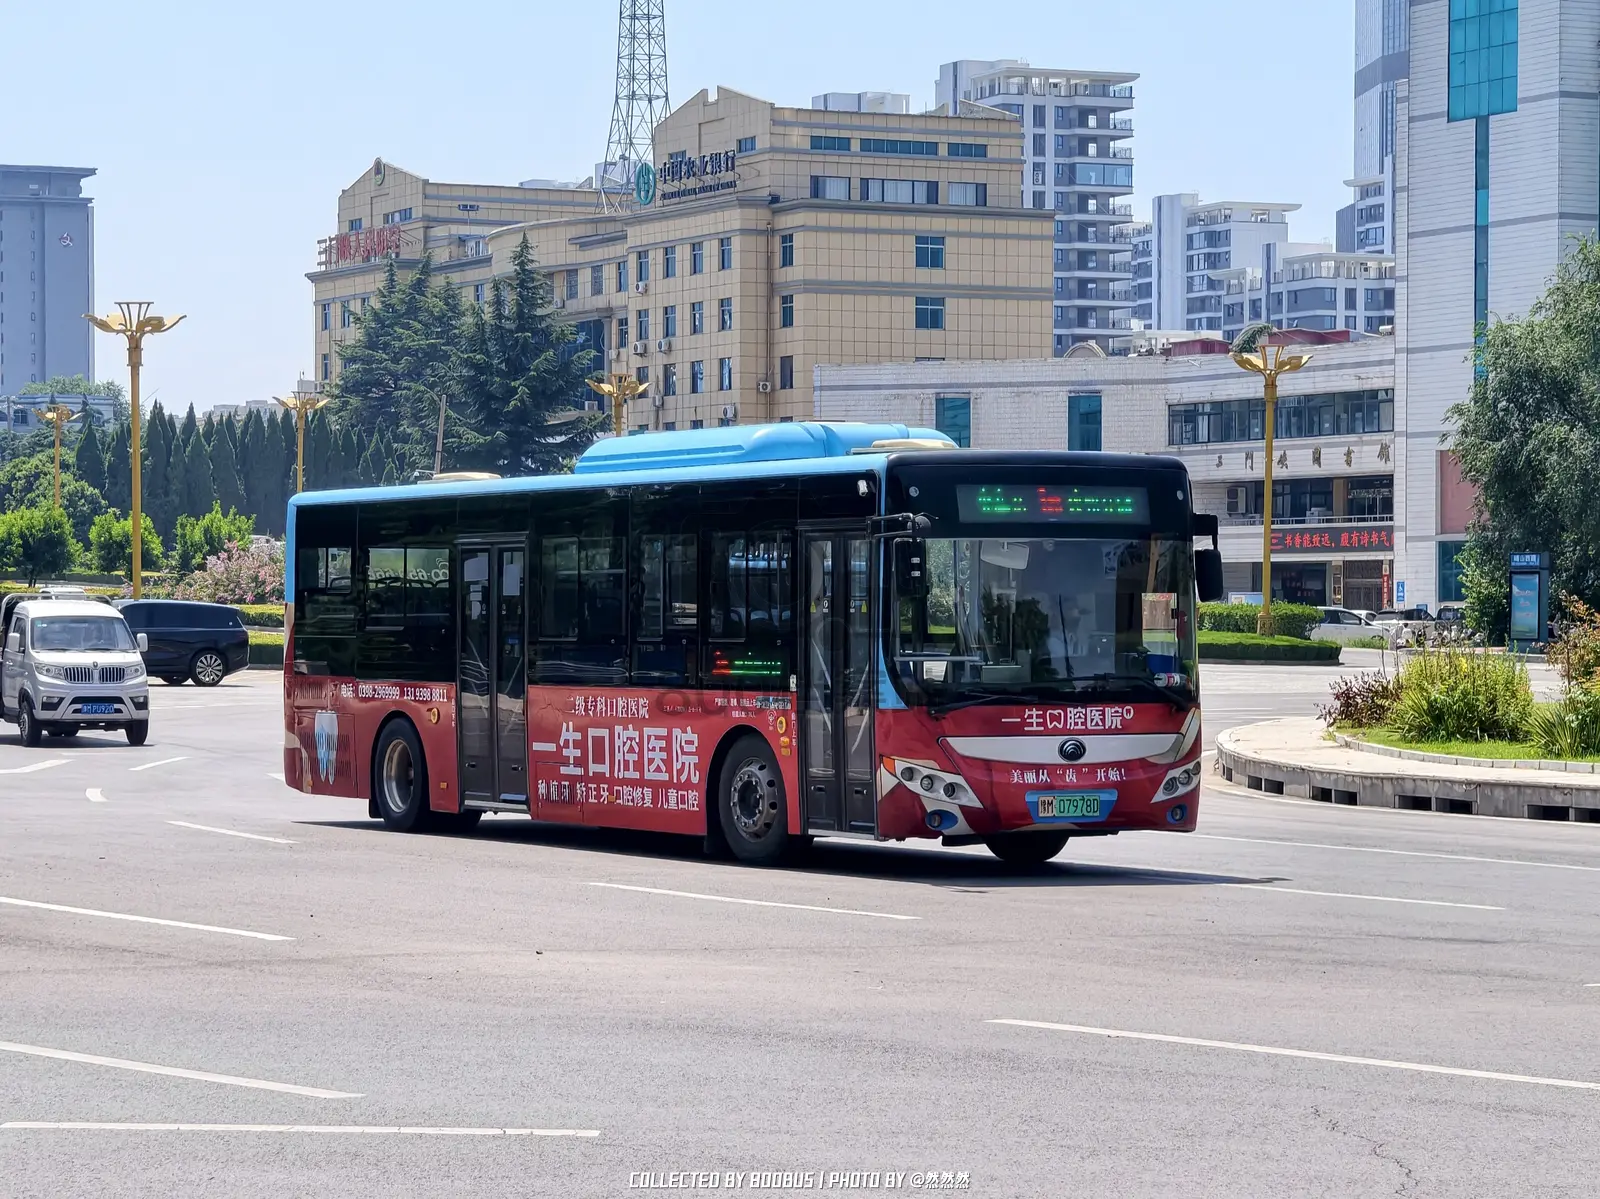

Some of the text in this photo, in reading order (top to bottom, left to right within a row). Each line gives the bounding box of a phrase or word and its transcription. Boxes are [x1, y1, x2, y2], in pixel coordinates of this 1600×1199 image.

[1284, 530, 1394, 549] 书香能致远，腹有诗书气
[359, 685, 400, 700] 0398-2969999
[403, 687, 415, 700] 131
[415, 688, 431, 701] 9398
[432, 689, 447, 702] 8811
[565, 695, 649, 719] 二级专科口腔医院
[532, 721, 699, 784] 一生口腔医院
[576, 782, 609, 805] 矫正牙
[613, 784, 653, 808] 口腔修复
[658, 787, 699, 811] 儿童口腔
